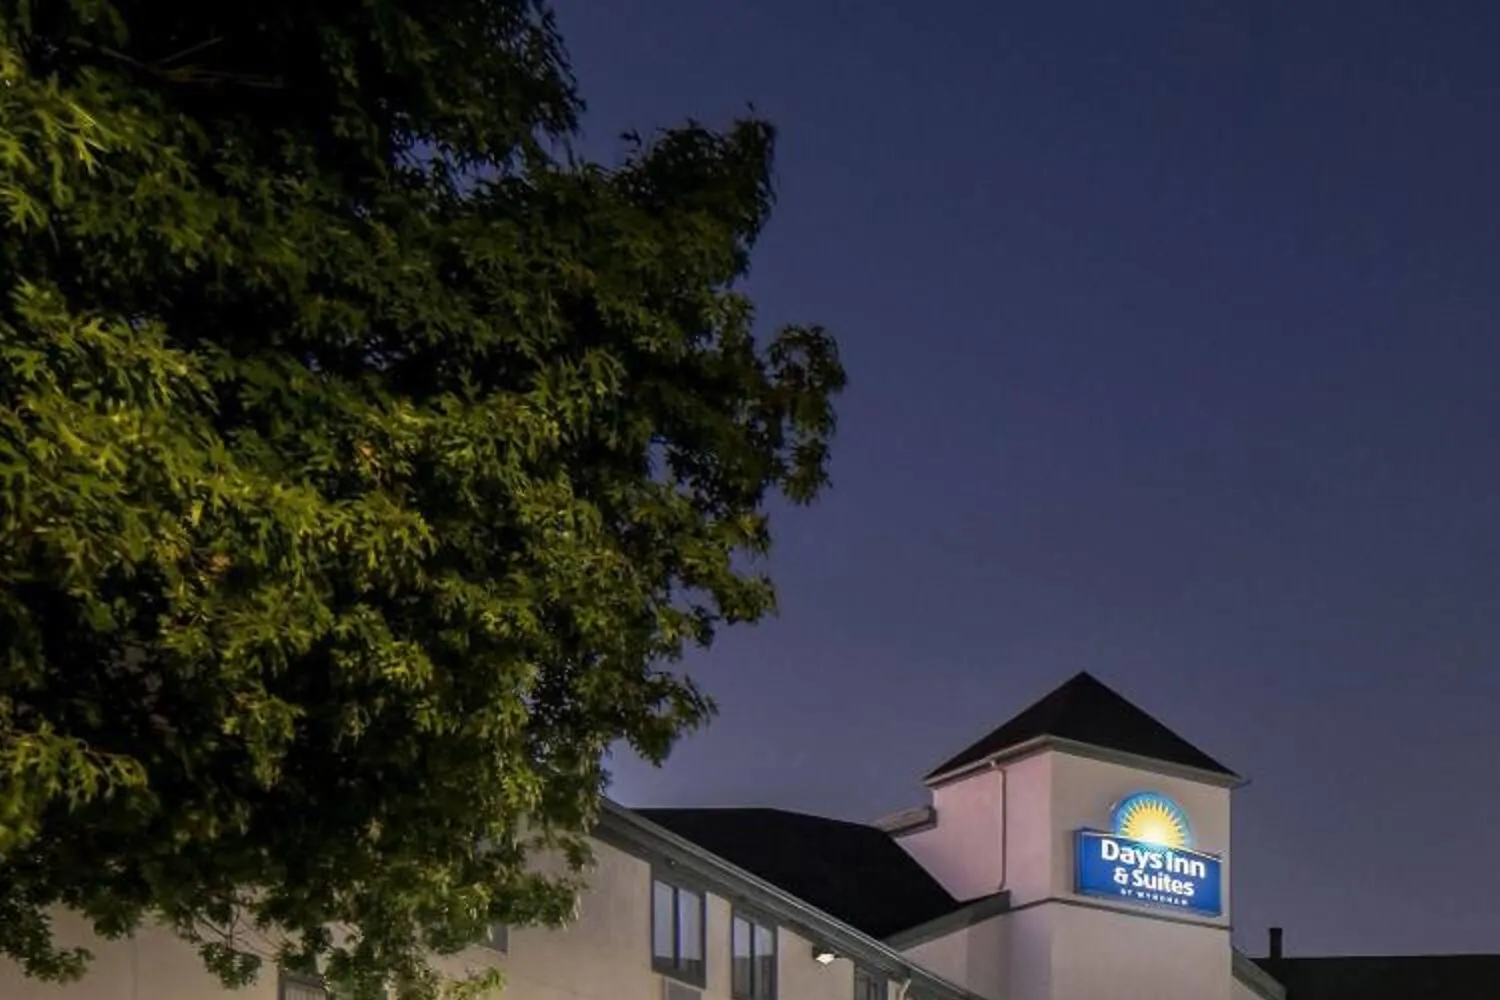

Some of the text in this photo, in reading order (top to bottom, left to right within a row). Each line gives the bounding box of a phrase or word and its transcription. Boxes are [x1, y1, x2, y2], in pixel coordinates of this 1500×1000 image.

[1101, 839, 1206, 879] Days Inn
[1113, 867, 1129, 885] &
[1132, 869, 1195, 897] Suites
